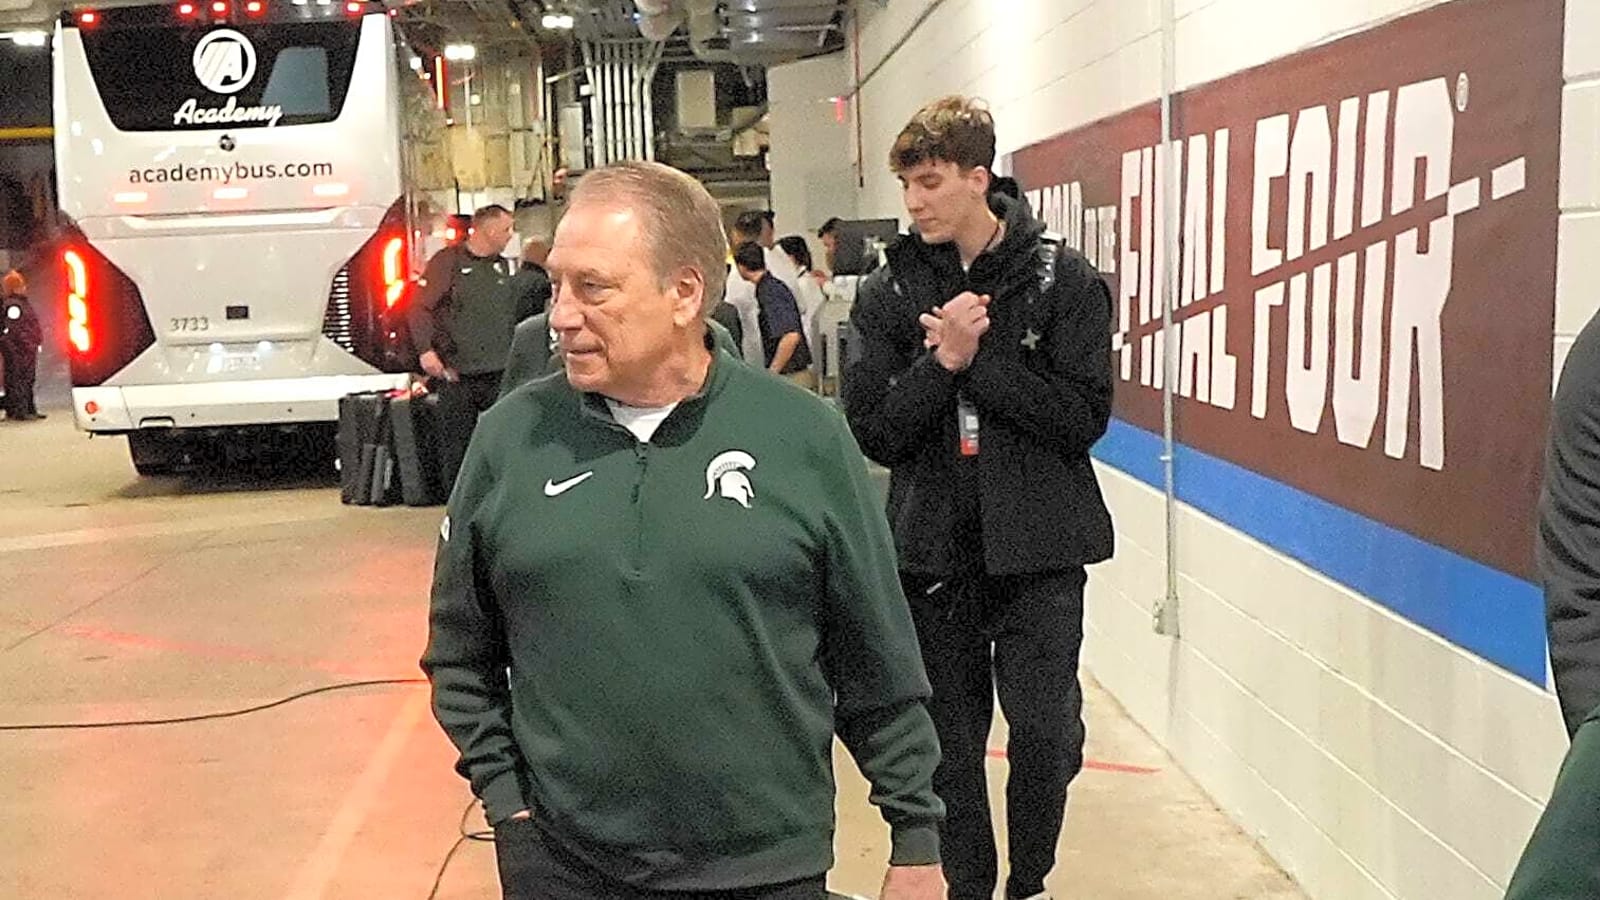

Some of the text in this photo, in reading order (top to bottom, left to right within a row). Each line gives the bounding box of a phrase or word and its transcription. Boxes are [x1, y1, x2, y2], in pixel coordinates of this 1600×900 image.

[173, 96, 282, 128] Academy
[129, 161, 333, 184] academybus.com
[1119, 77, 1455, 470] FINAL FOUR
[169, 316, 209, 332] 3733
